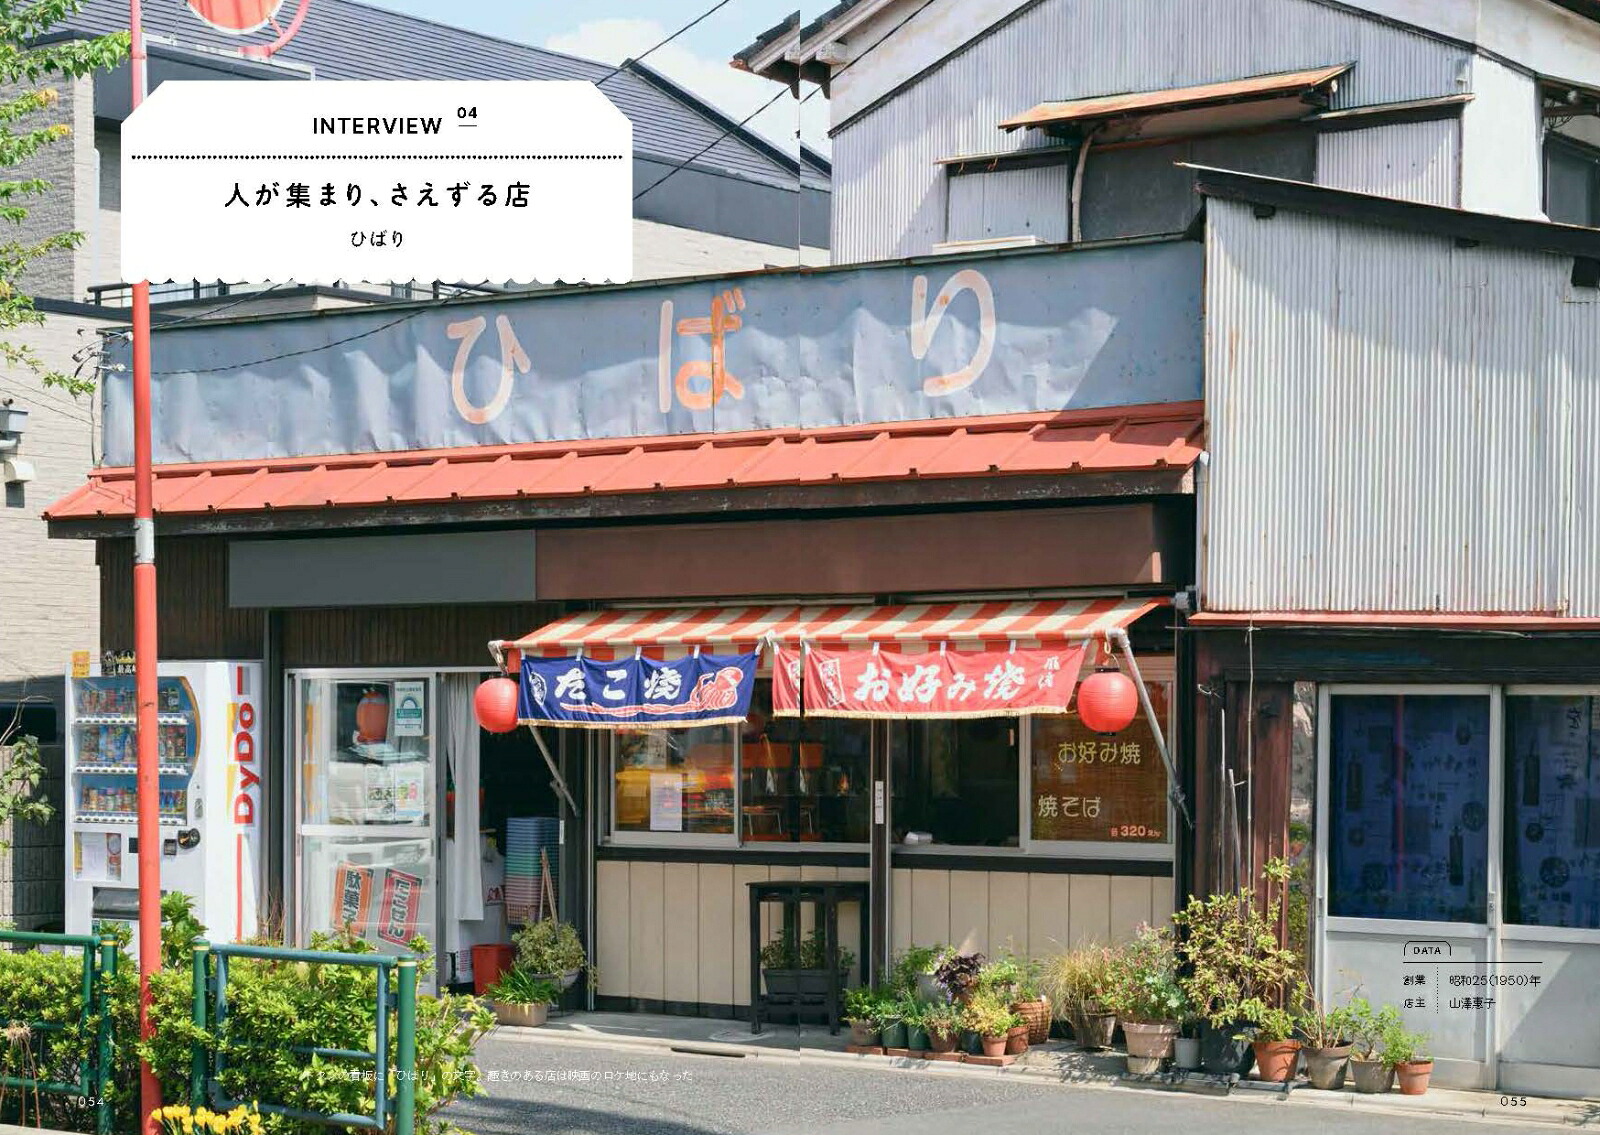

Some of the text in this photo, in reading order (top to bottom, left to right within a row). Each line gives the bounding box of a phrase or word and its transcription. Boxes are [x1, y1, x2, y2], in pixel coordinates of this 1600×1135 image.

[447, 268, 996, 425] ひばり
[554, 667, 682, 700] たこ焼
[854, 660, 1025, 703] お好み焼
[234, 702, 260, 824] DyDo
[1058, 741, 1141, 765] お好み焼
[1038, 795, 1101, 818] 焼そば
